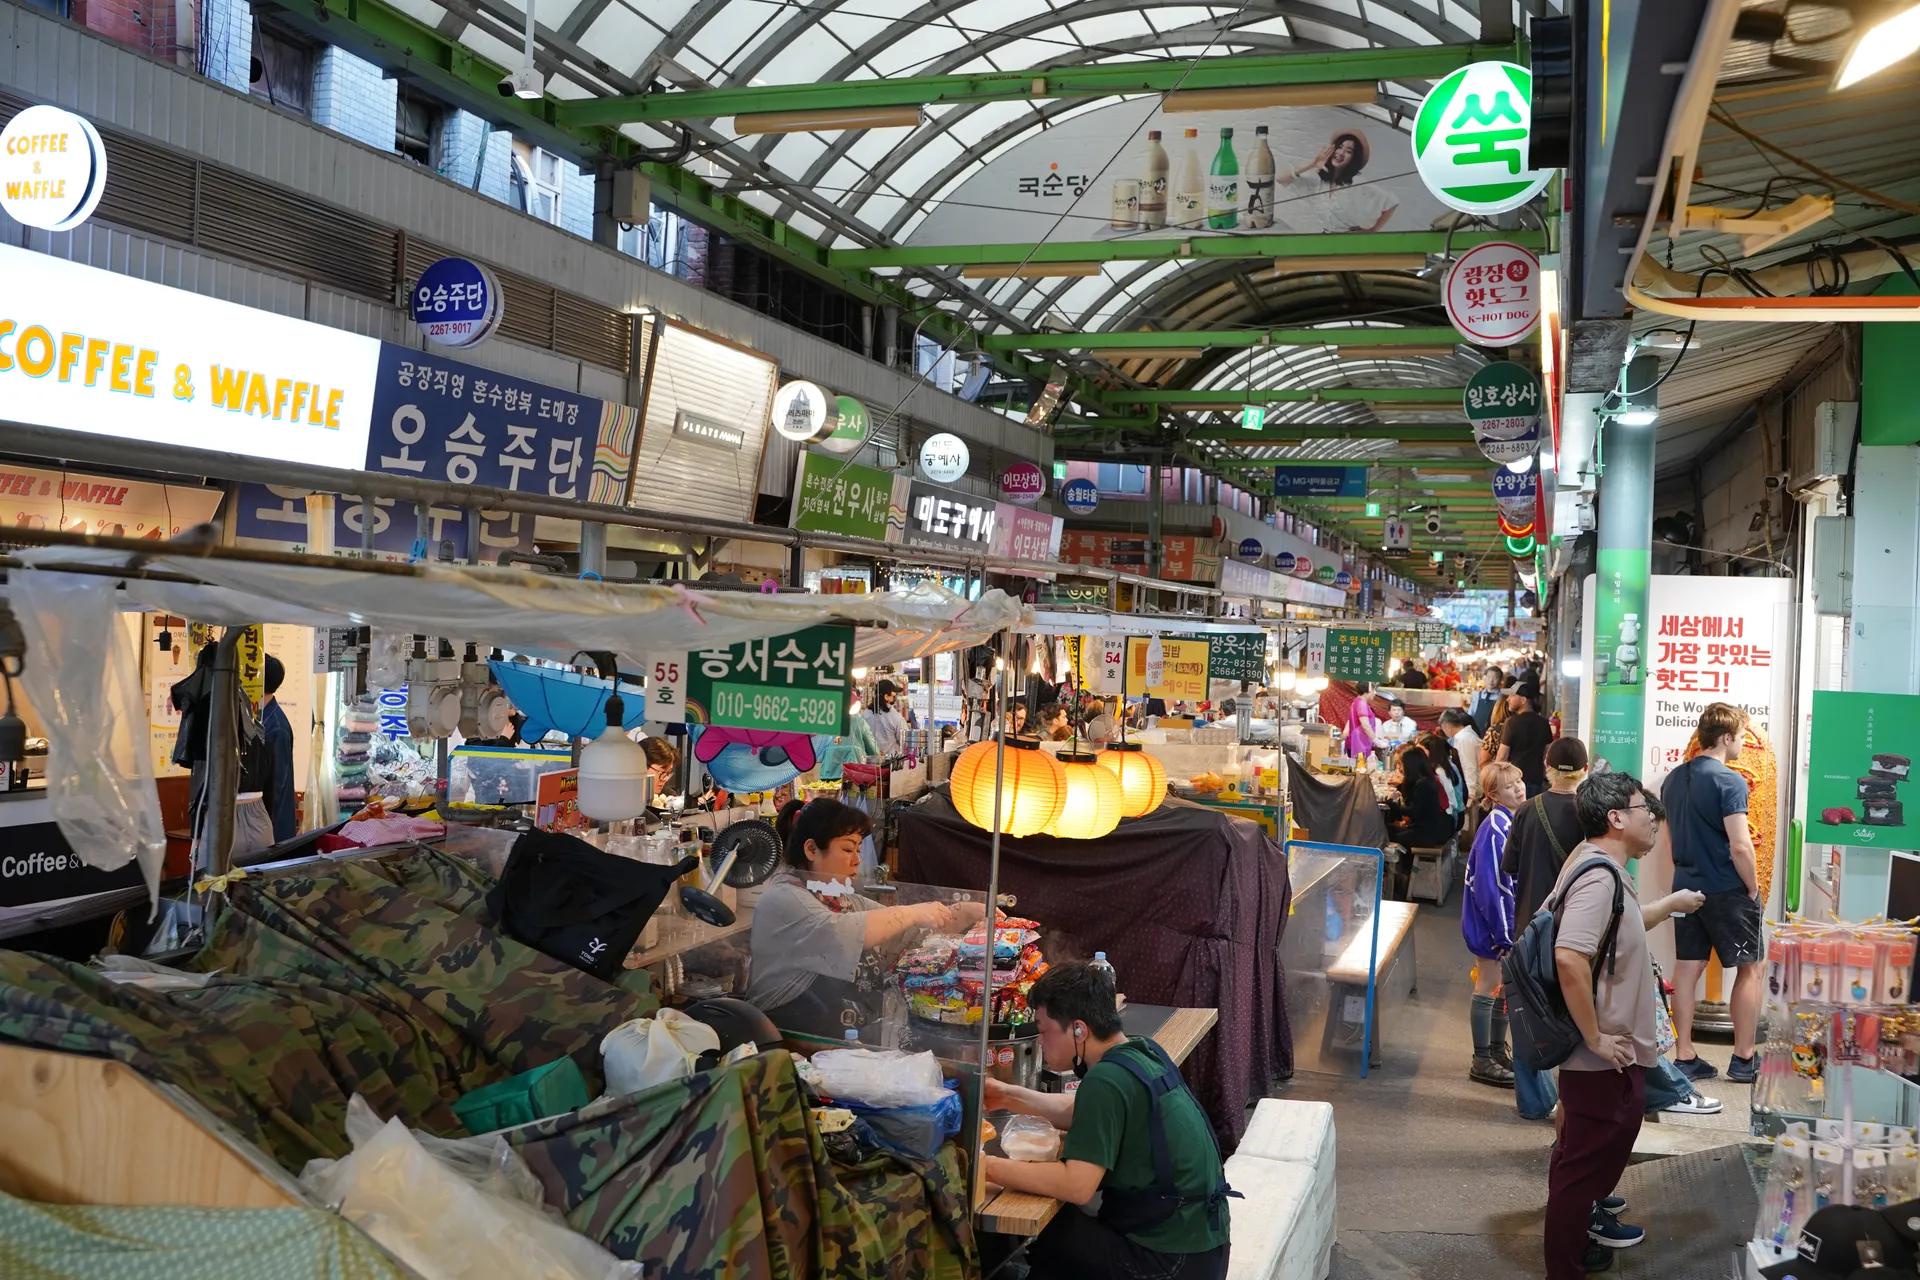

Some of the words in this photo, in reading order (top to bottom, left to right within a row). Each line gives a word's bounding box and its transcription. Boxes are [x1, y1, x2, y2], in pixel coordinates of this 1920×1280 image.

[7, 133, 68, 156] COFFEE
[1447, 92, 1528, 174] 쑥
[6, 179, 65, 200] WAFFLE
[1019, 164, 1090, 198] 국순당
[1463, 264, 1505, 285] 광장
[416, 281, 483, 313] 오승주단
[1465, 286, 1529, 309] 핫도그
[1468, 312, 1503, 323] K-HOT
[1506, 310, 1529, 320] DOG
[172, 363, 195, 401] &
[210, 364, 345, 431] WAFFLE
[397, 361, 465, 399] 공장직영
[472, 380, 533, 415] 혼수한복
[537, 398, 580, 426] 도매장
[1468, 382, 1537, 408] 일호상사
[837, 413, 862, 433] 우사
[1482, 417, 1526, 431] 2267-2803
[381, 403, 584, 499] 오승주단
[925, 453, 961, 466] 공예사
[1003, 472, 1040, 489] 이모상회
[57, 480, 129, 506] WAFFLE
[833, 478, 876, 522] 천우사
[919, 495, 995, 544] 미도공예사
[1013, 533, 1050, 561] 이모상회
[1658, 615, 1744, 640] 세상에서
[1105, 651, 1121, 664] 54
[1211, 635, 1265, 657] 장옷수선
[1310, 651, 1322, 662] 11
[1657, 642, 1701, 667] 가장
[1707, 643, 1772, 668] 맛있는
[655, 661, 679, 684] 55
[1106, 668, 1116, 679] 호
[1210, 656, 1258, 669] 272-8257
[1655, 667, 1730, 693] 핫도그!
[655, 686, 676, 706] 호
[716, 691, 837, 726] 010-9662-5928
[1656, 700, 1680, 712] The
[1737, 703, 1769, 716] Most
[1656, 715, 1700, 728] Delicio
[1665, 748, 1680, 763] 광
[2, 852, 67, 878] Coffee
[69, 853, 79, 869] &
